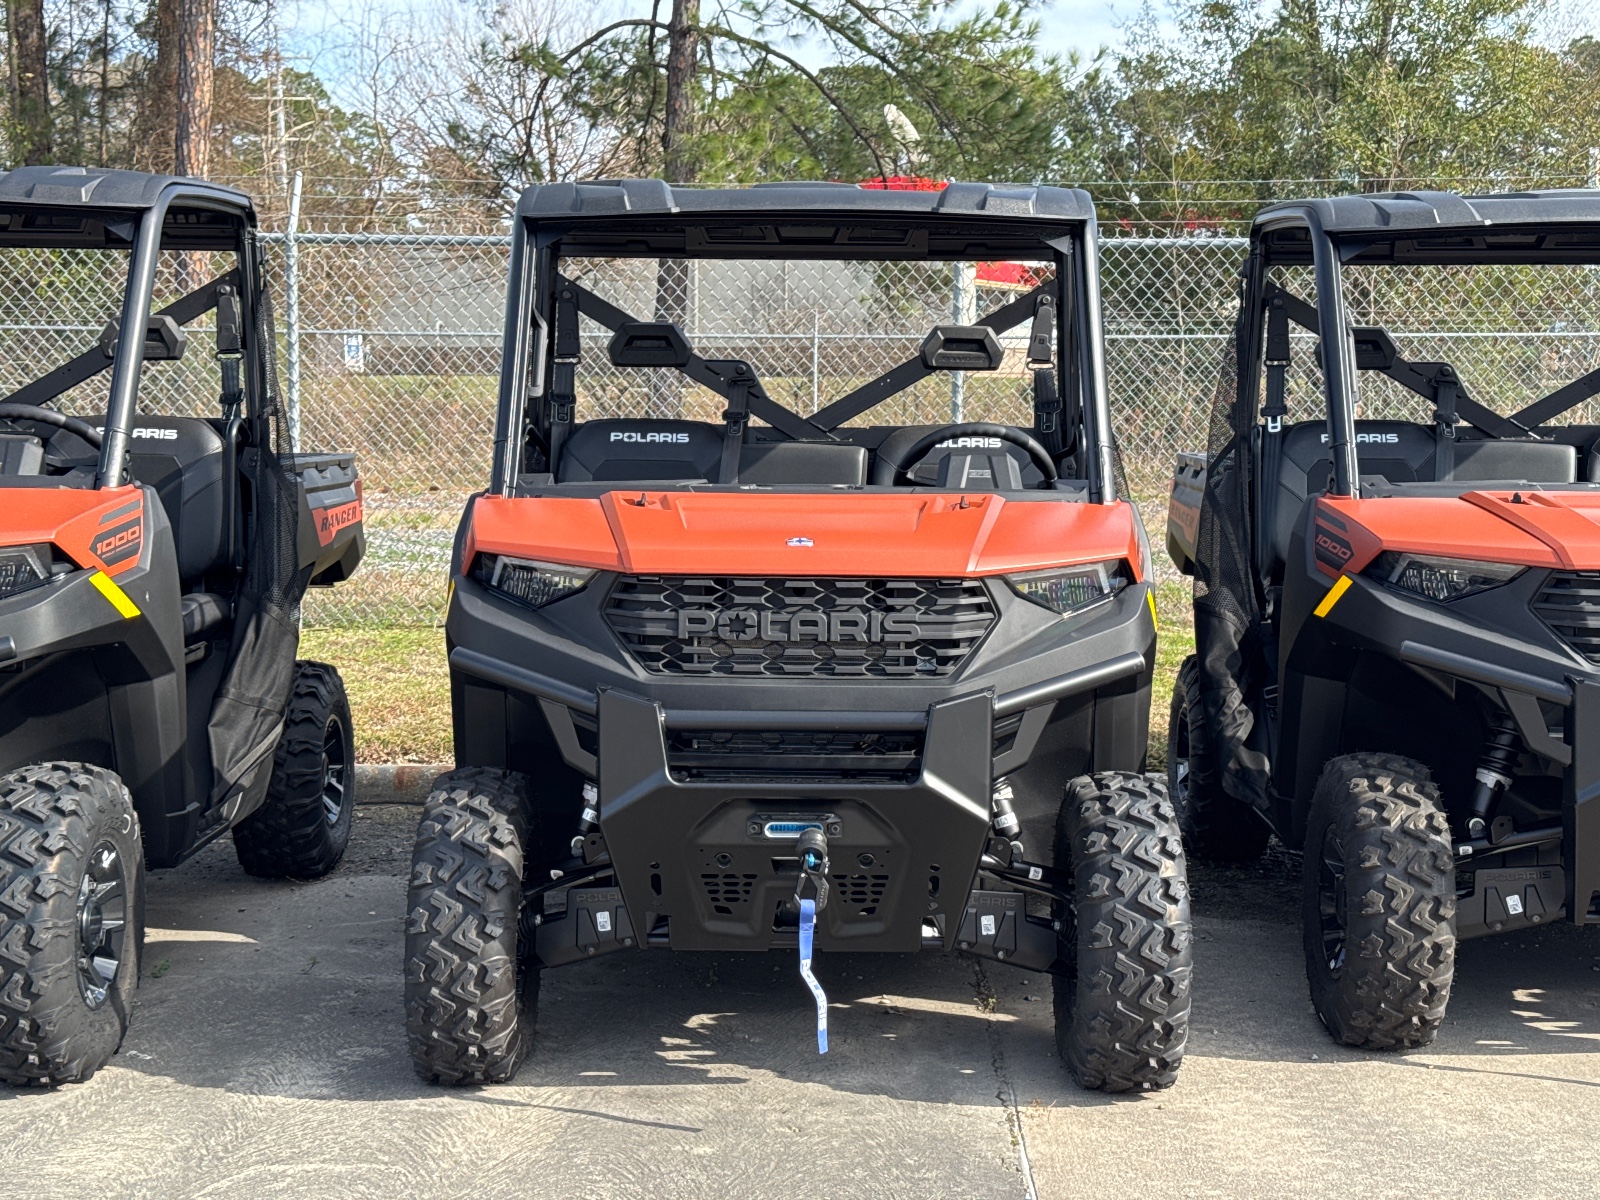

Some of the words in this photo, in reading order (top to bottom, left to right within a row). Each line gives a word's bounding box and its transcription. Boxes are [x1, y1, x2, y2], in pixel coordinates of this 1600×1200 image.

[609, 431, 690, 443] POLARIS
[934, 437, 1002, 448] LARIS
[1320, 433, 1399, 443] PARIS
[320, 506, 357, 532] RANGER
[96, 525, 140, 556] 1000
[1315, 533, 1352, 560] 1000
[677, 609, 921, 643] POLARIS
[1483, 870, 1552, 882] POLARIS
[576, 892, 623, 903] POLA
[969, 895, 1017, 907] LARIS
[800, 959, 827, 1031] POLARIS
